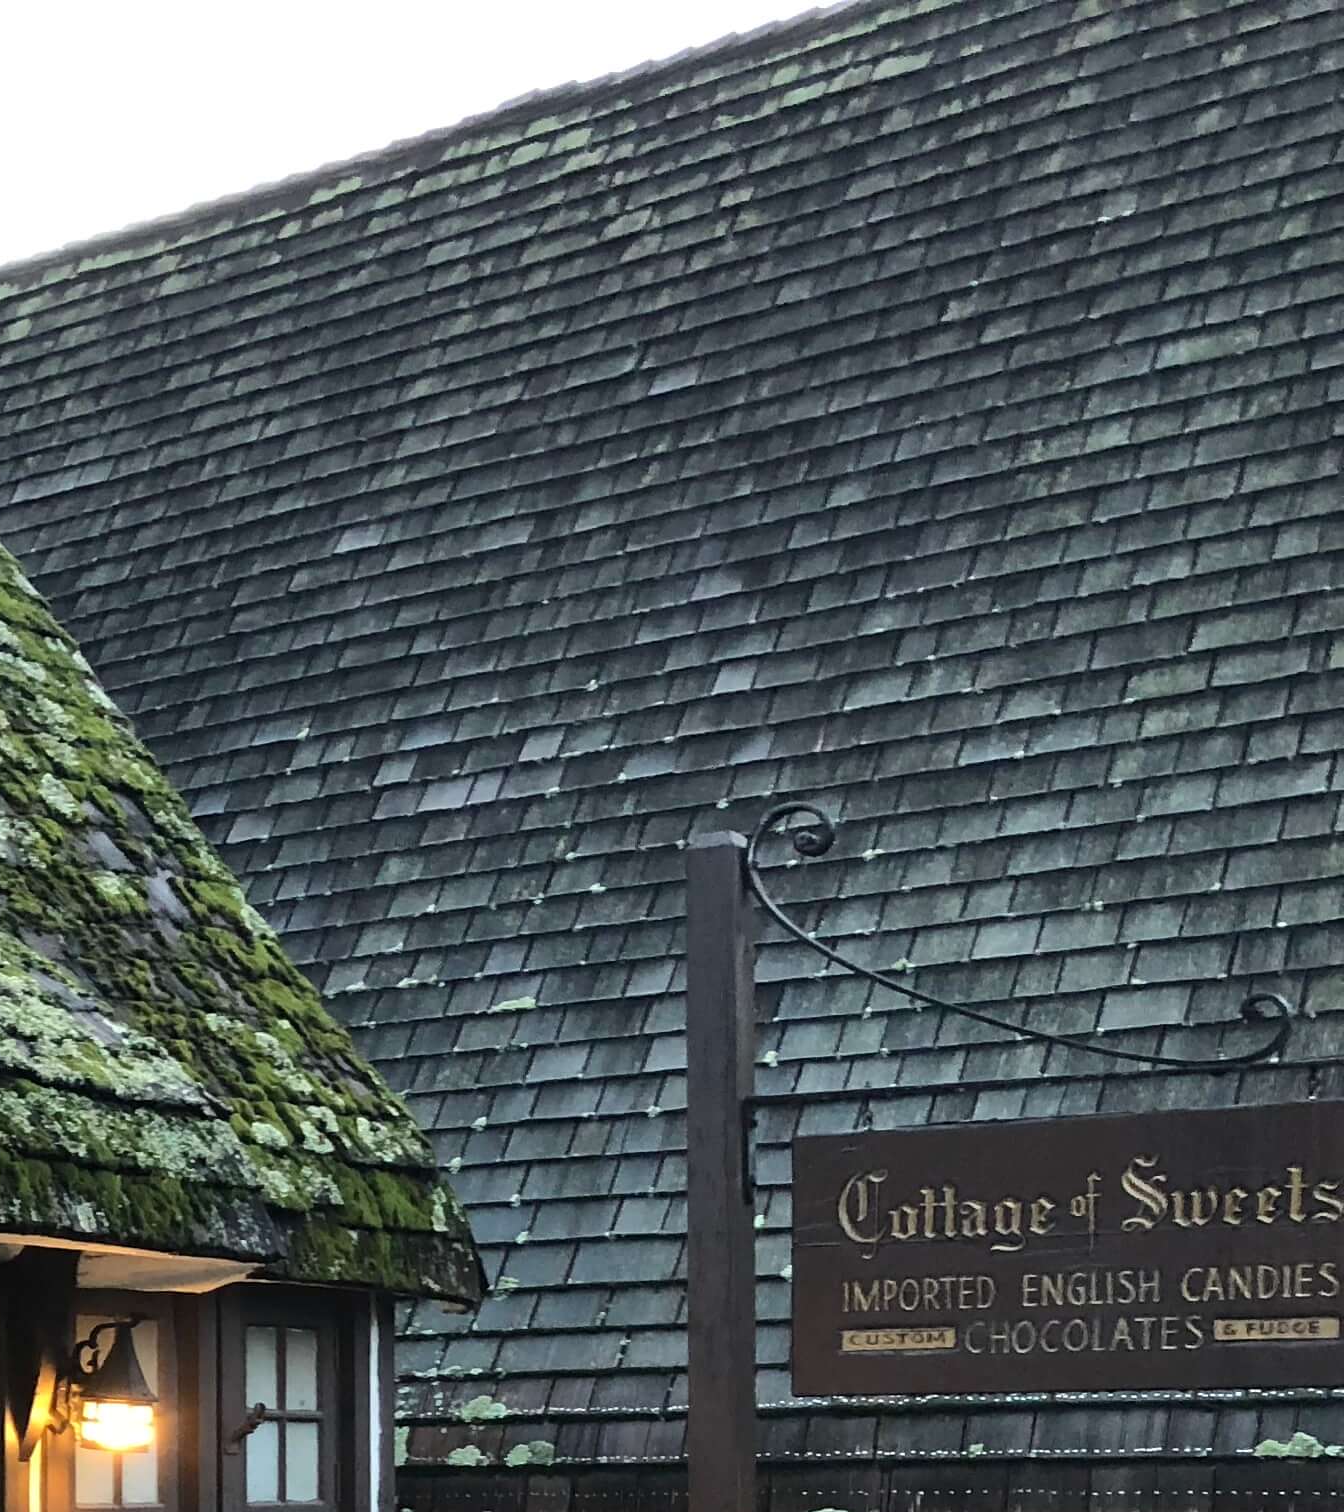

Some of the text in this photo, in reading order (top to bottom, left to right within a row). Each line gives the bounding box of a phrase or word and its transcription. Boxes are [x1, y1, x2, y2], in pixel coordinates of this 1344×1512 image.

[838, 1154, 1344, 1260] Cottage of Sweets
[842, 1262, 1340, 1313] IMPORTED ENGLISH CANDIES
[848, 1315, 1321, 1354] CUSTOM CHOCOLATES & FUDGE
